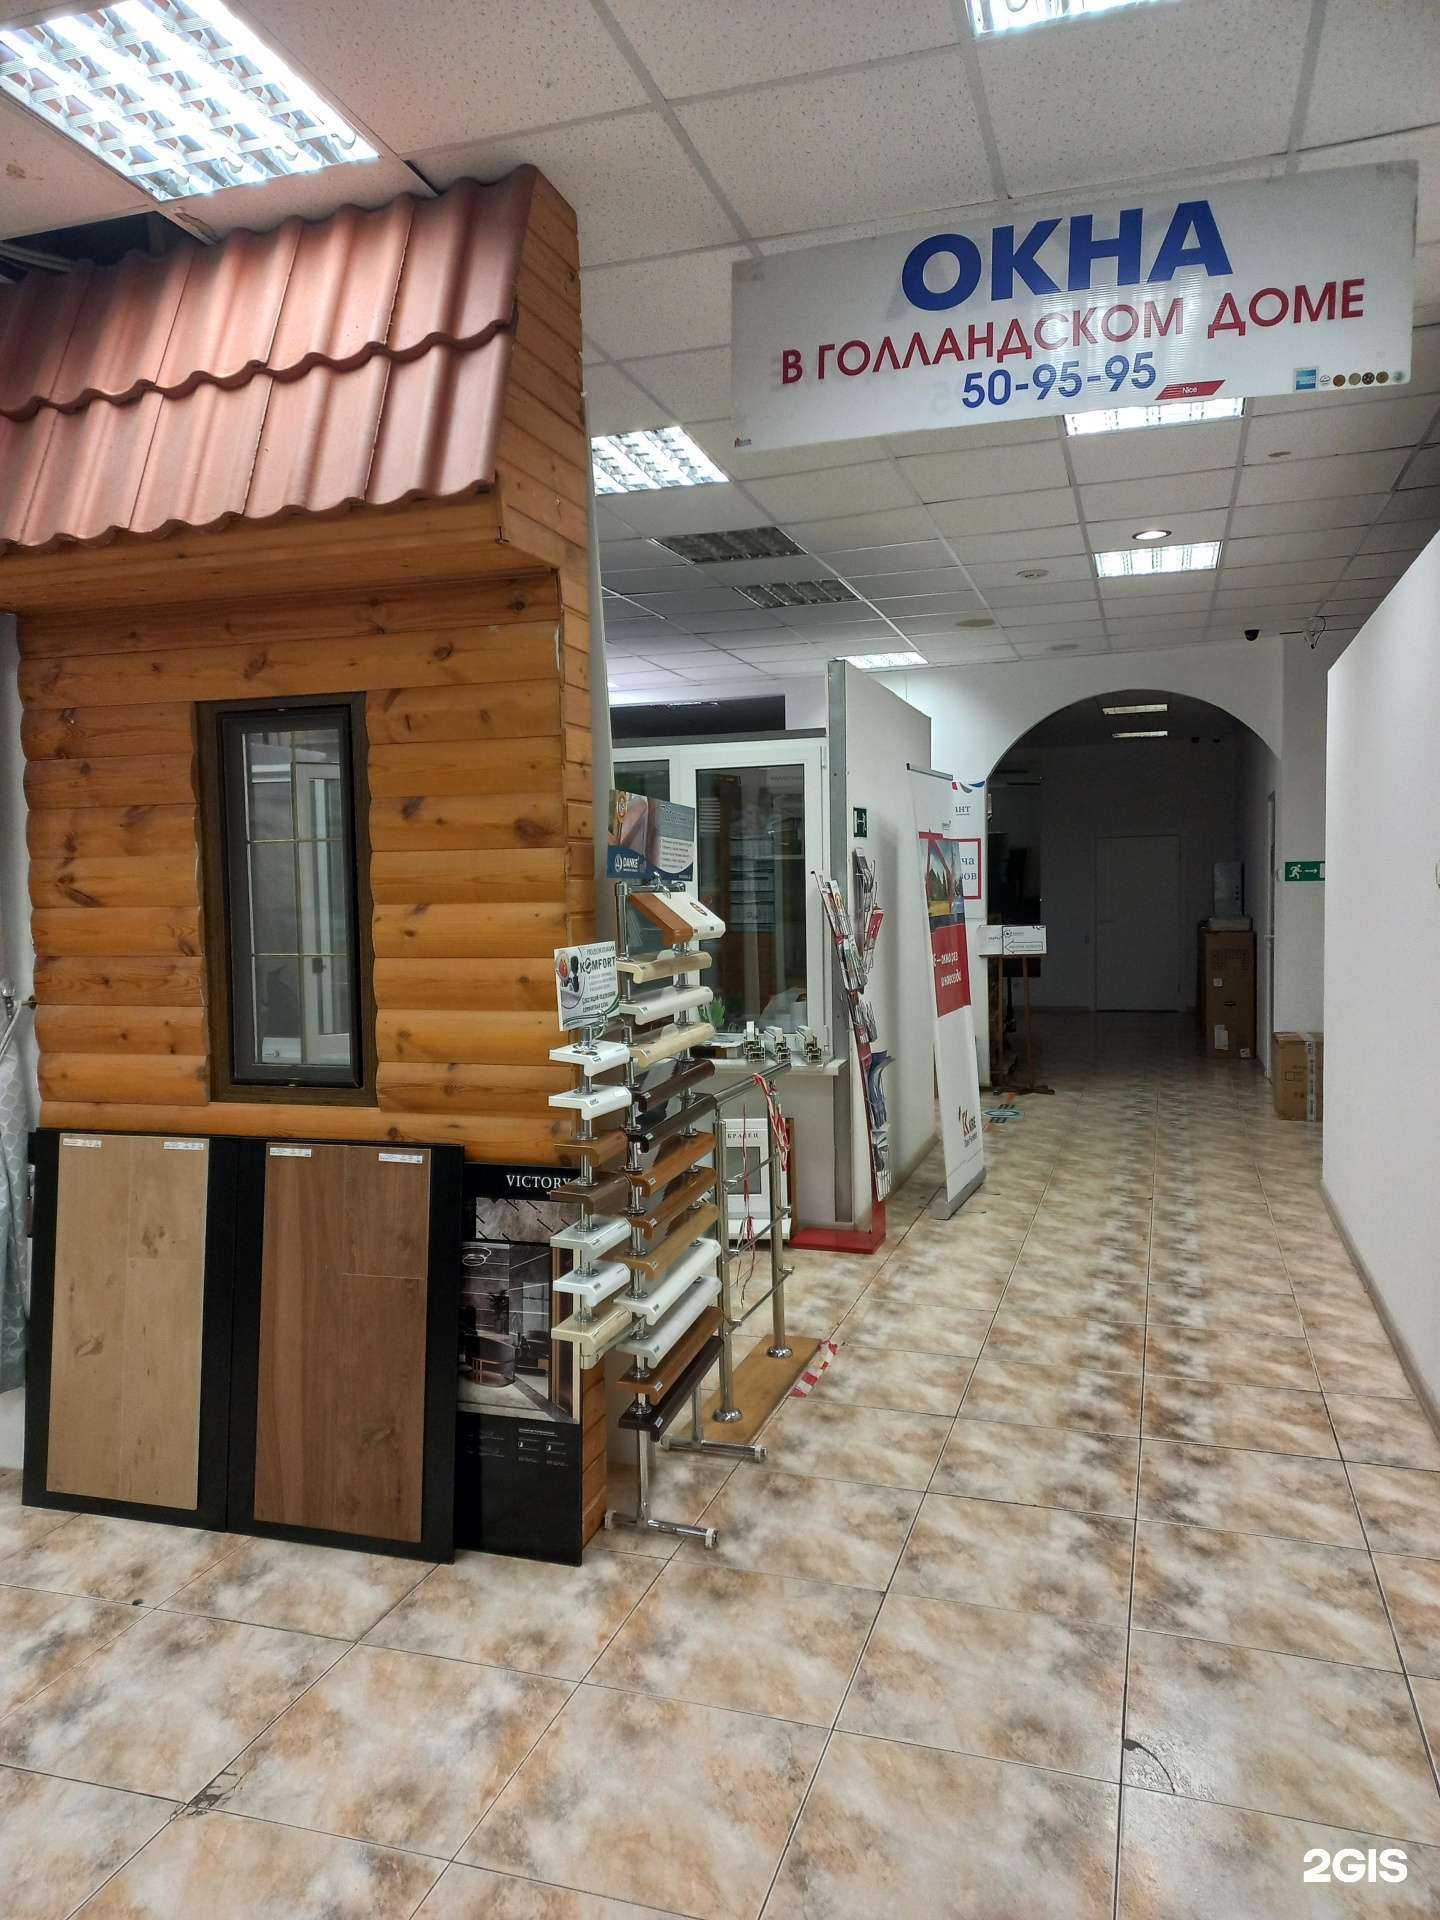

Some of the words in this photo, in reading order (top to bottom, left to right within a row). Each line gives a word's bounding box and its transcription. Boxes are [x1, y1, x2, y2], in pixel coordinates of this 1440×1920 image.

[901, 200, 1232, 312] ОКНА
[782, 347, 802, 384] В
[818, 297, 1183, 381] ГОЛЛАНДСКОМ
[1208, 278, 1364, 339] ДОМЕ
[961, 352, 1157, 408] 50-95-95
[580, 956, 616, 974] KOMFORT
